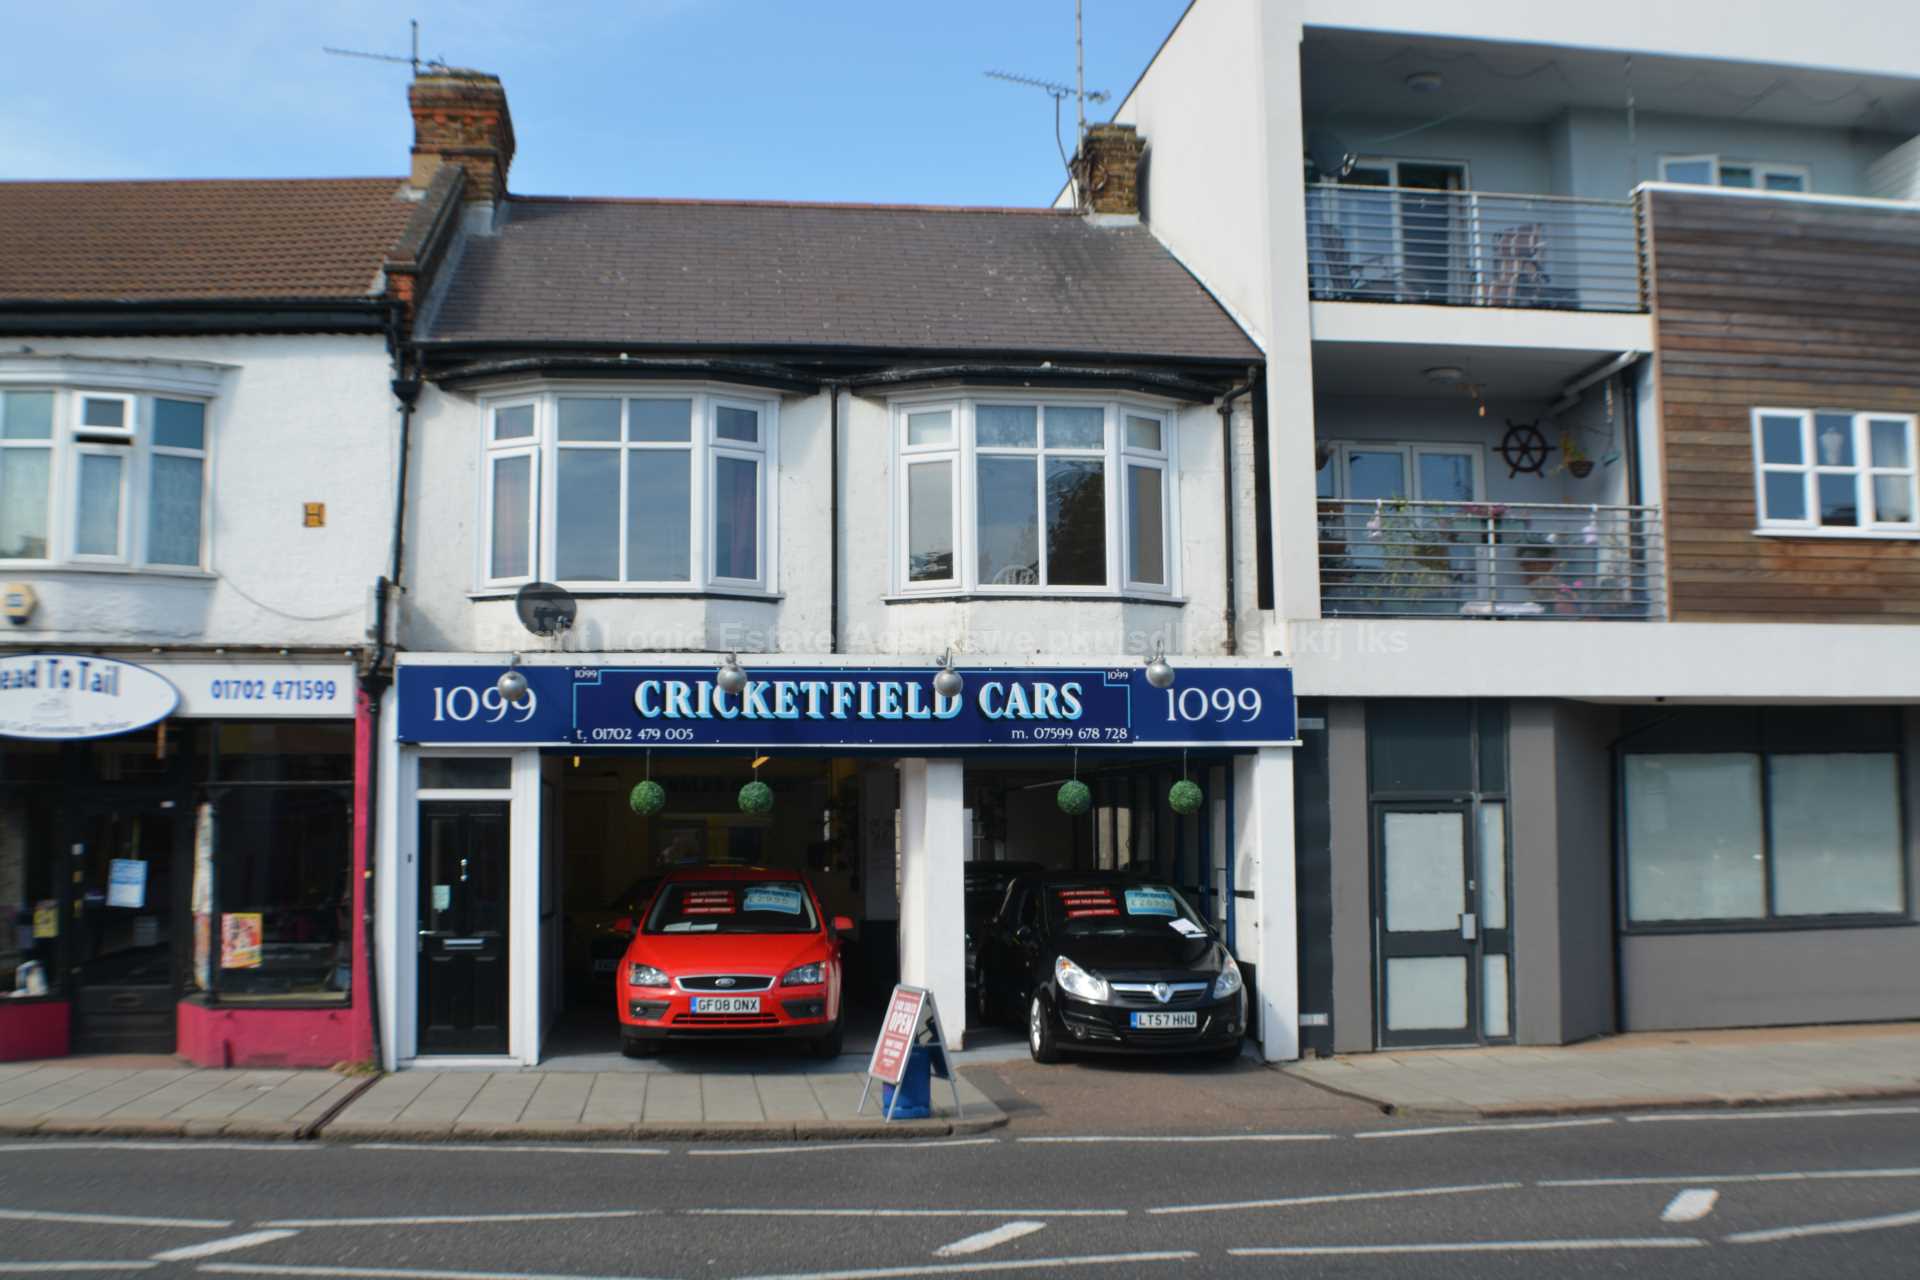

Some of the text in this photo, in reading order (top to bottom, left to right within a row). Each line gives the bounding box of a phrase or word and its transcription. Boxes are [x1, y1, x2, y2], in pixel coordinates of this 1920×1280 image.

[0, 659, 120, 697] ead To Tail
[574, 668, 598, 679] 1099
[1107, 670, 1129, 680] 1099
[211, 679, 337, 700] 01702 471599
[432, 685, 538, 723] 1099
[634, 680, 1083, 720] CRICKETFIELD CARS
[1165, 687, 1262, 723] 1099
[592, 727, 632, 740] 01702
[638, 728, 661, 740] 479
[665, 728, 694, 740] 005
[1012, 727, 1128, 740] m. 07599 678 728
[698, 999, 757, 1011] GF08 ONX
[1139, 1013, 1195, 1026] LT57 HHU
